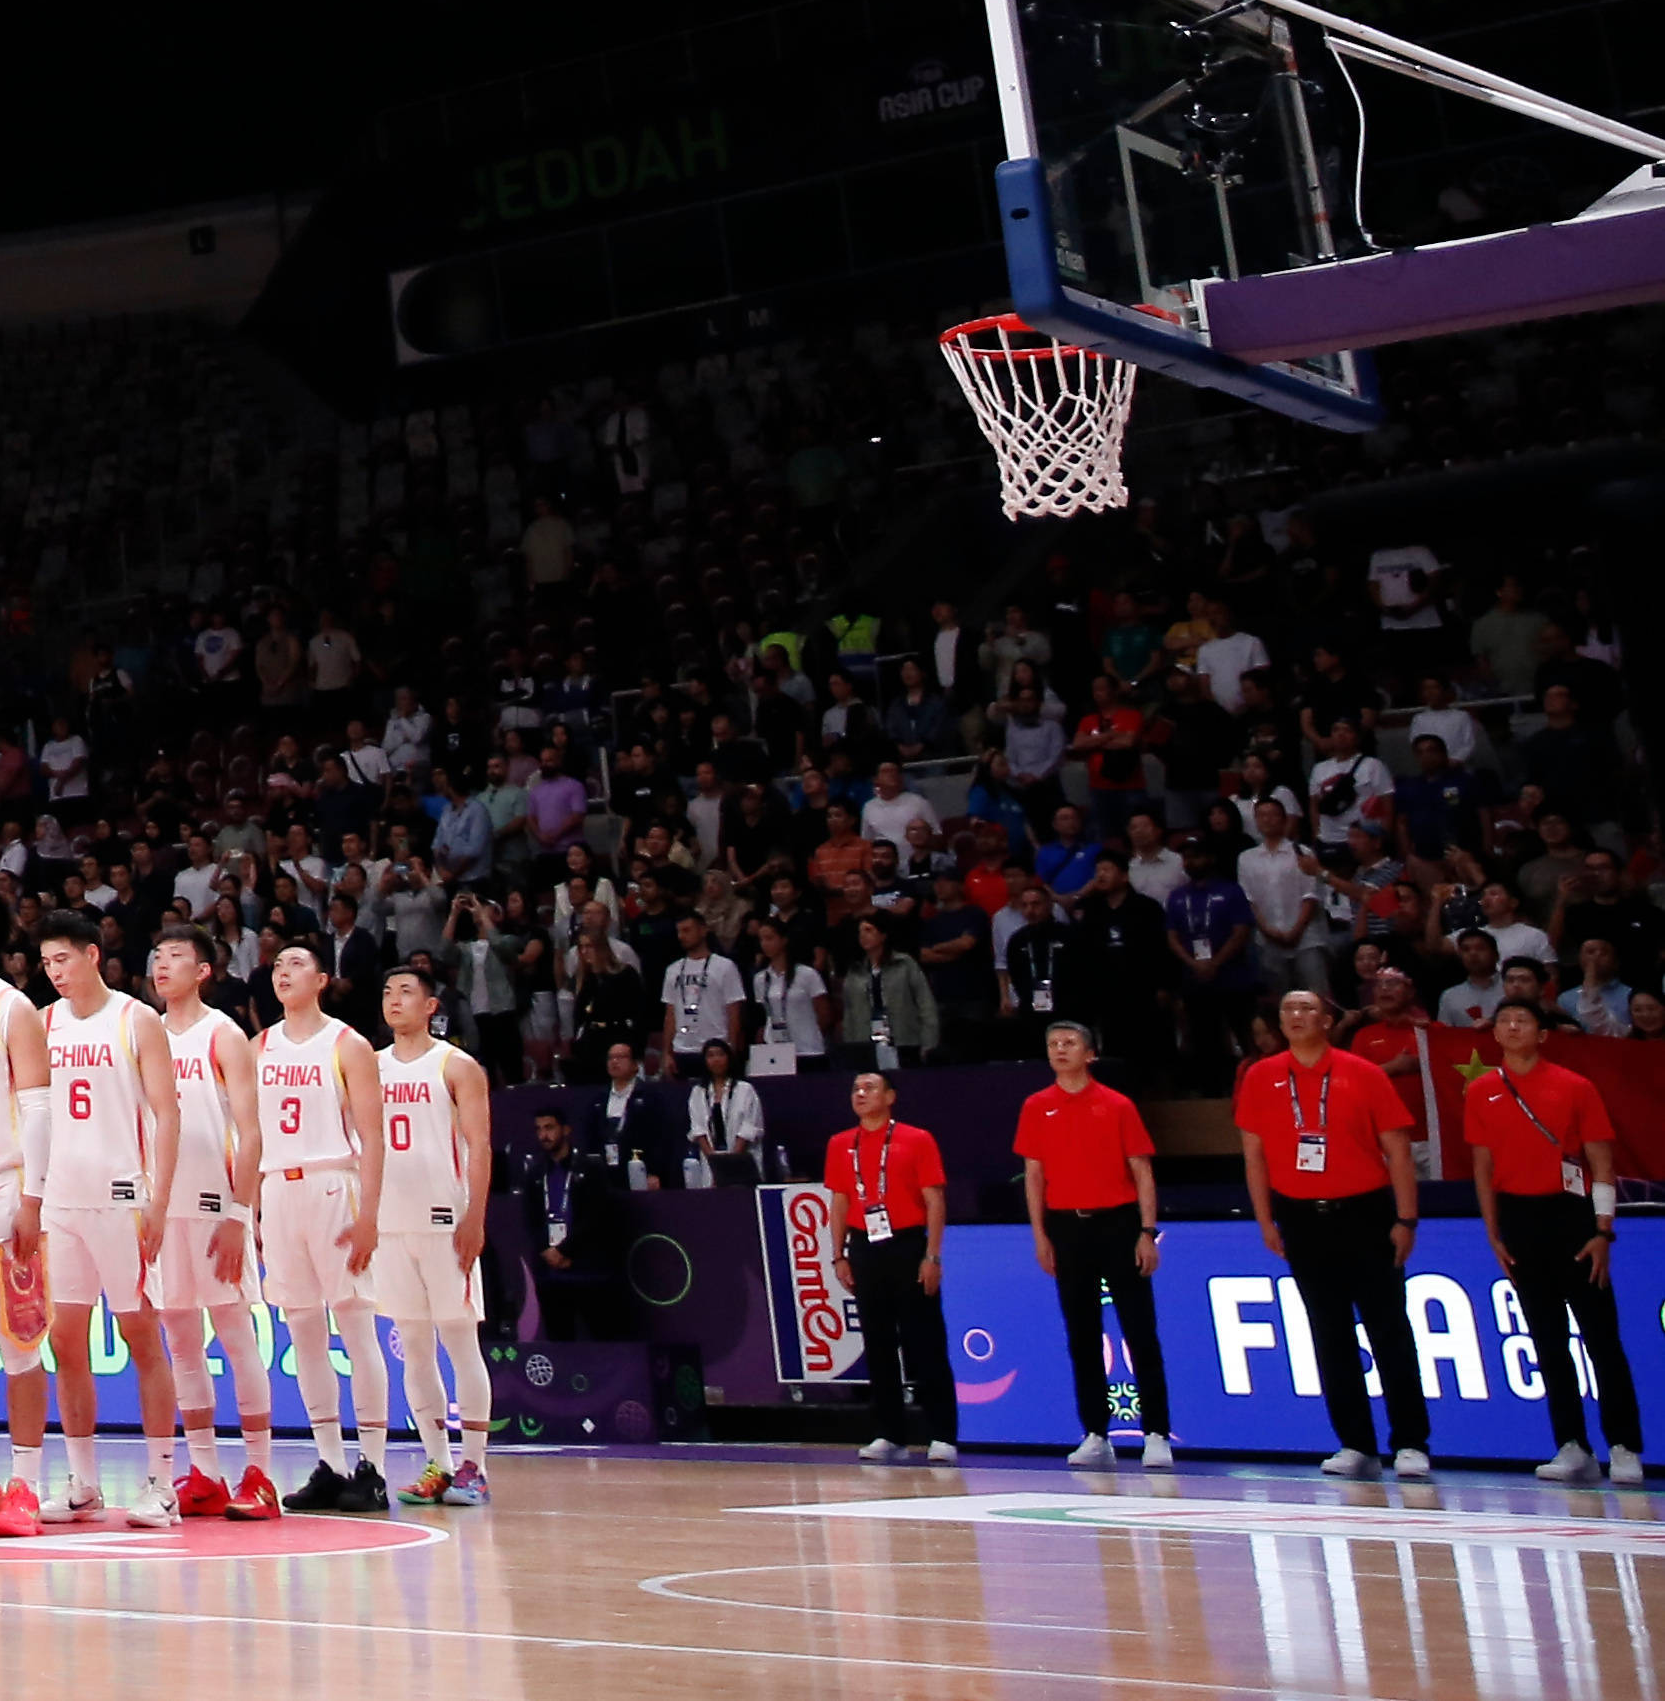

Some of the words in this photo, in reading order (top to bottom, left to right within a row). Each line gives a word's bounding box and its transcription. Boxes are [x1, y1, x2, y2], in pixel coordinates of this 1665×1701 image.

[49, 1043, 114, 1068] CHINA
[262, 1065, 322, 1086] CHINA
[381, 1082, 431, 1103] HINA
[69, 1079, 91, 1120] 6
[280, 1097, 301, 1134] 3
[390, 1114, 410, 1151] 0
[1208, 1273, 1489, 1400] FIA
